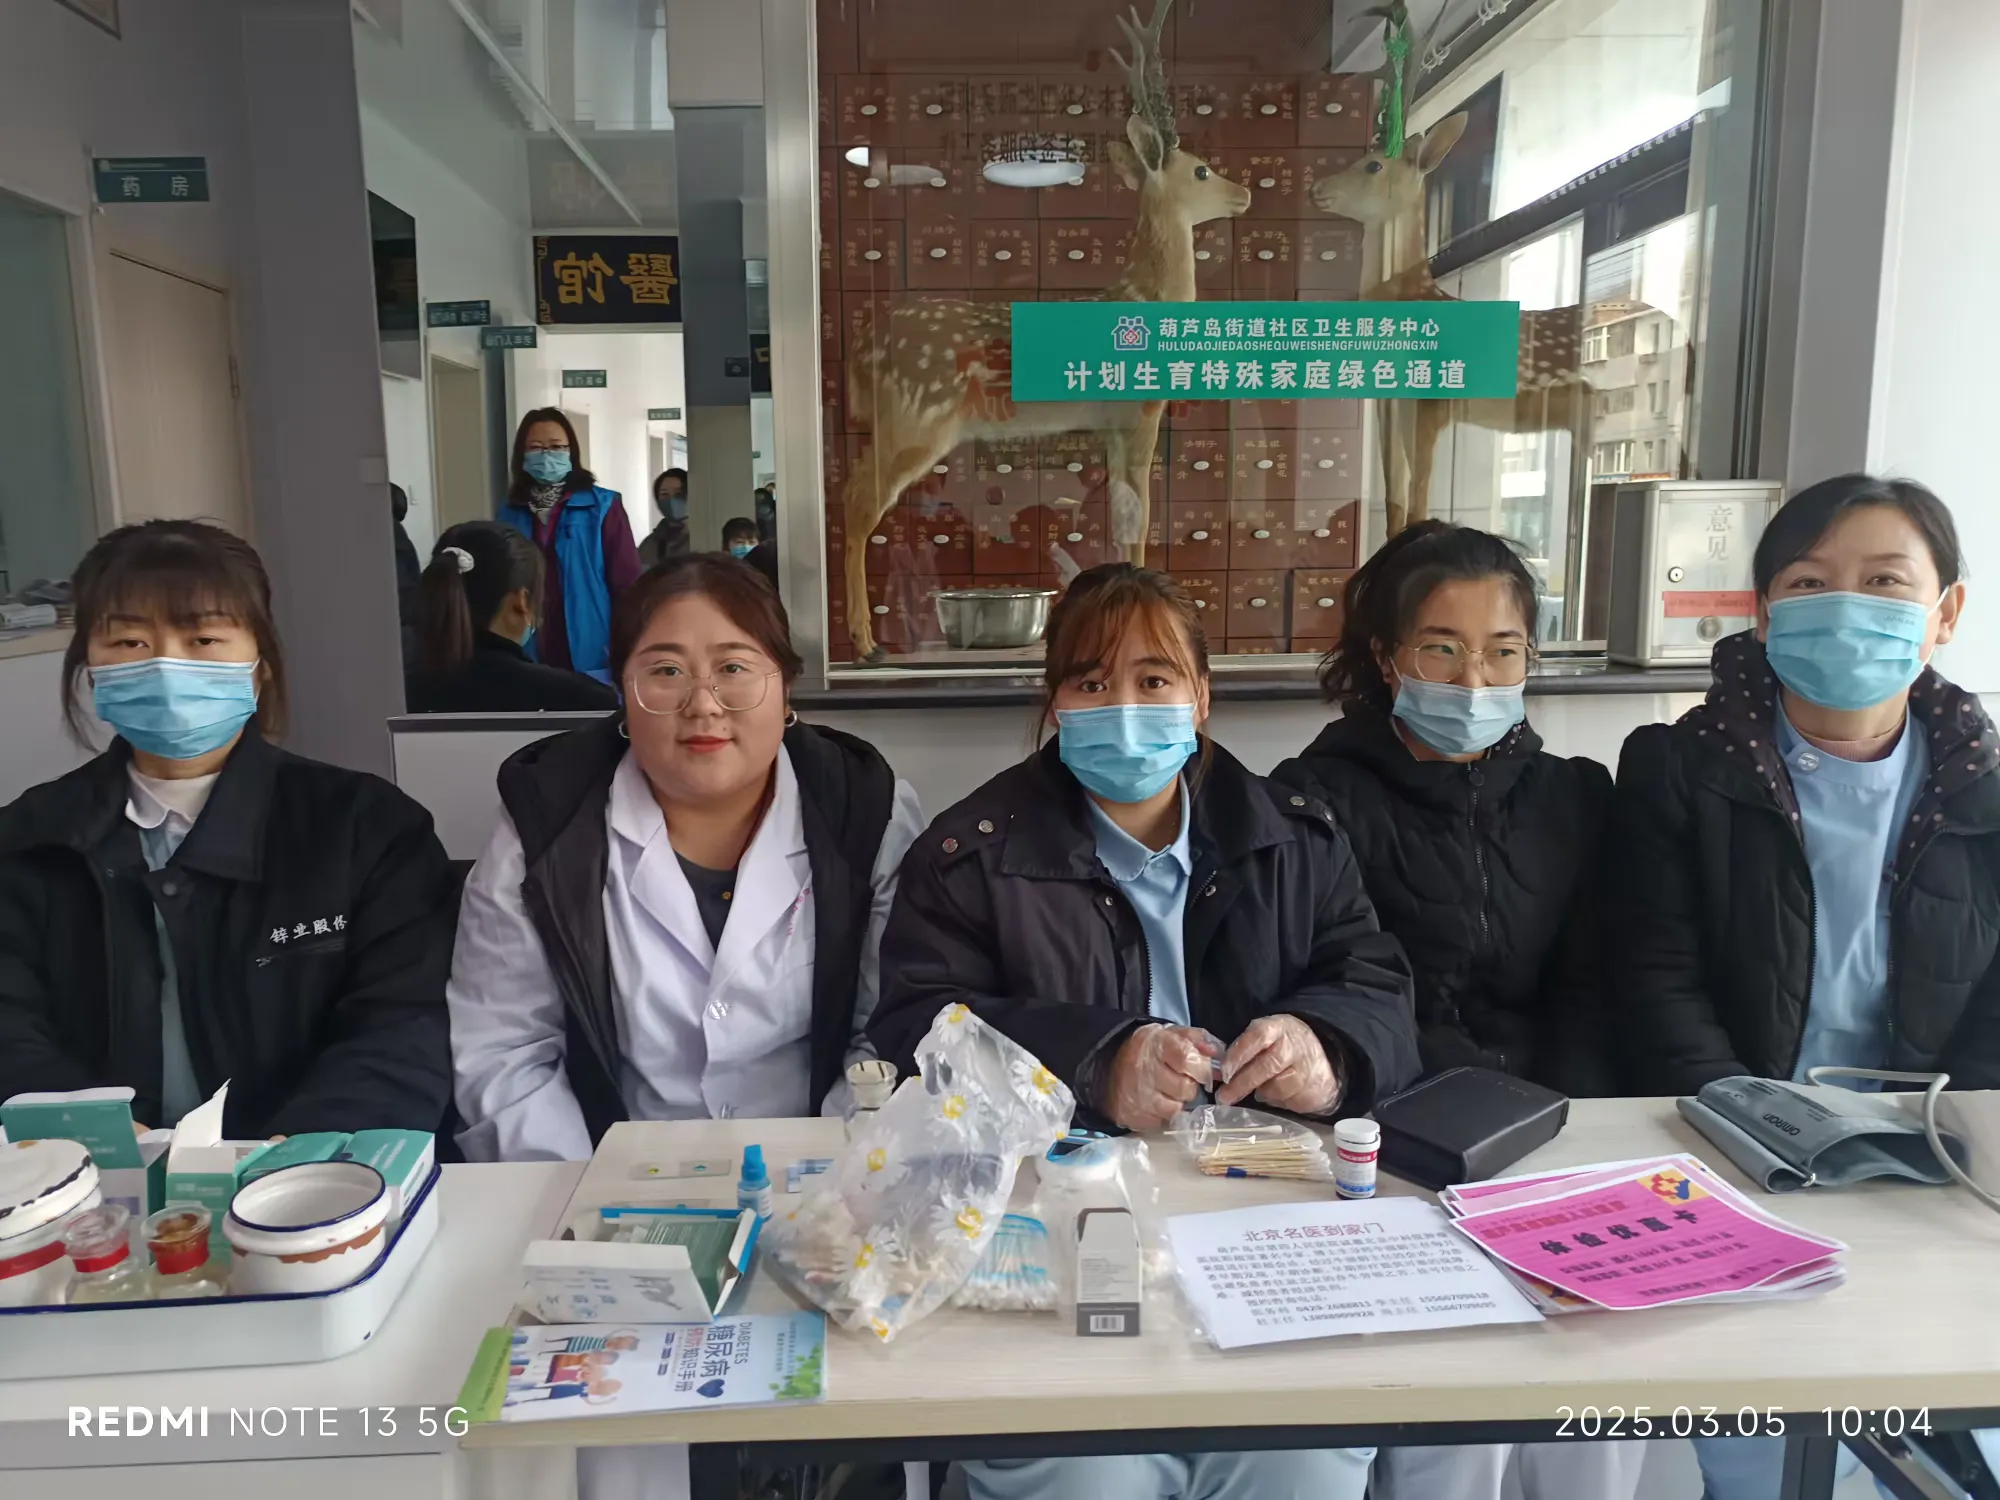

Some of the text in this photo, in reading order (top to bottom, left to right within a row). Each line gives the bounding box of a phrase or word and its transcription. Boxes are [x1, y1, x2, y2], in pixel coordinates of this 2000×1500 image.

[120, 176, 190, 197] 药房
[1158, 317, 1441, 339] 葫芦岛街道社区卫生服务中心
[1157, 341, 1439, 351] HULUDAOJIEDAOSHEQUWEISHENGFUWUZHONGXIN
[1064, 359, 1468, 391] 计划生育特殊家庭绿色通道
[269, 914, 348, 944] 锌业股份
[1242, 1221, 1385, 1243] 北京名医到家门
[1539, 1209, 1699, 1255] 体检优惠卡
[700, 1324, 735, 1378] 糖尿病
[735, 1321, 750, 1365] DIABETES
[674, 1326, 701, 1393] 预防知识手册
